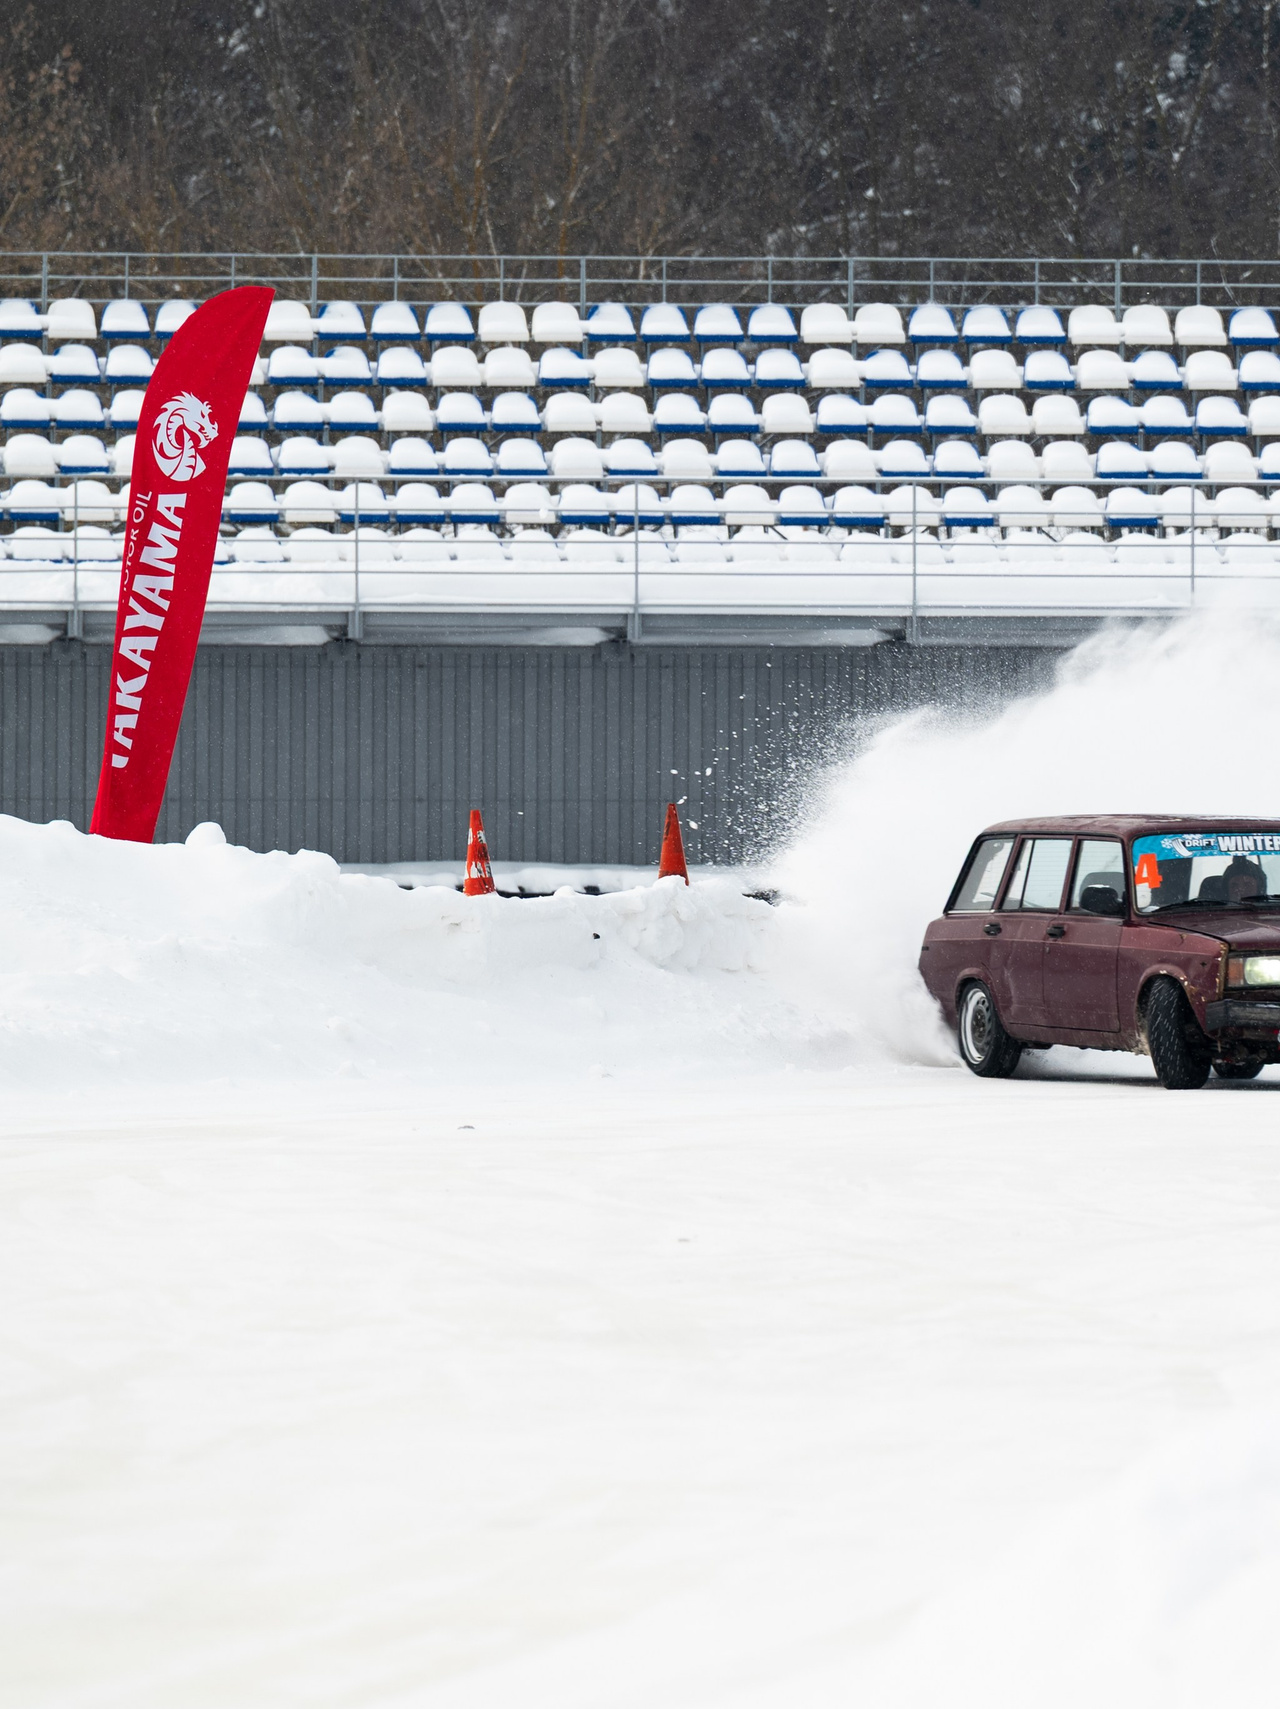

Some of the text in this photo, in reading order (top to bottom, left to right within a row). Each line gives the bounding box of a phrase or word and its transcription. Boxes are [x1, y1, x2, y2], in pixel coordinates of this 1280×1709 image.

[132, 490, 153, 523] OIL
[1184, 838, 1216, 847] DRIFT
[1135, 853, 1163, 889] 4
